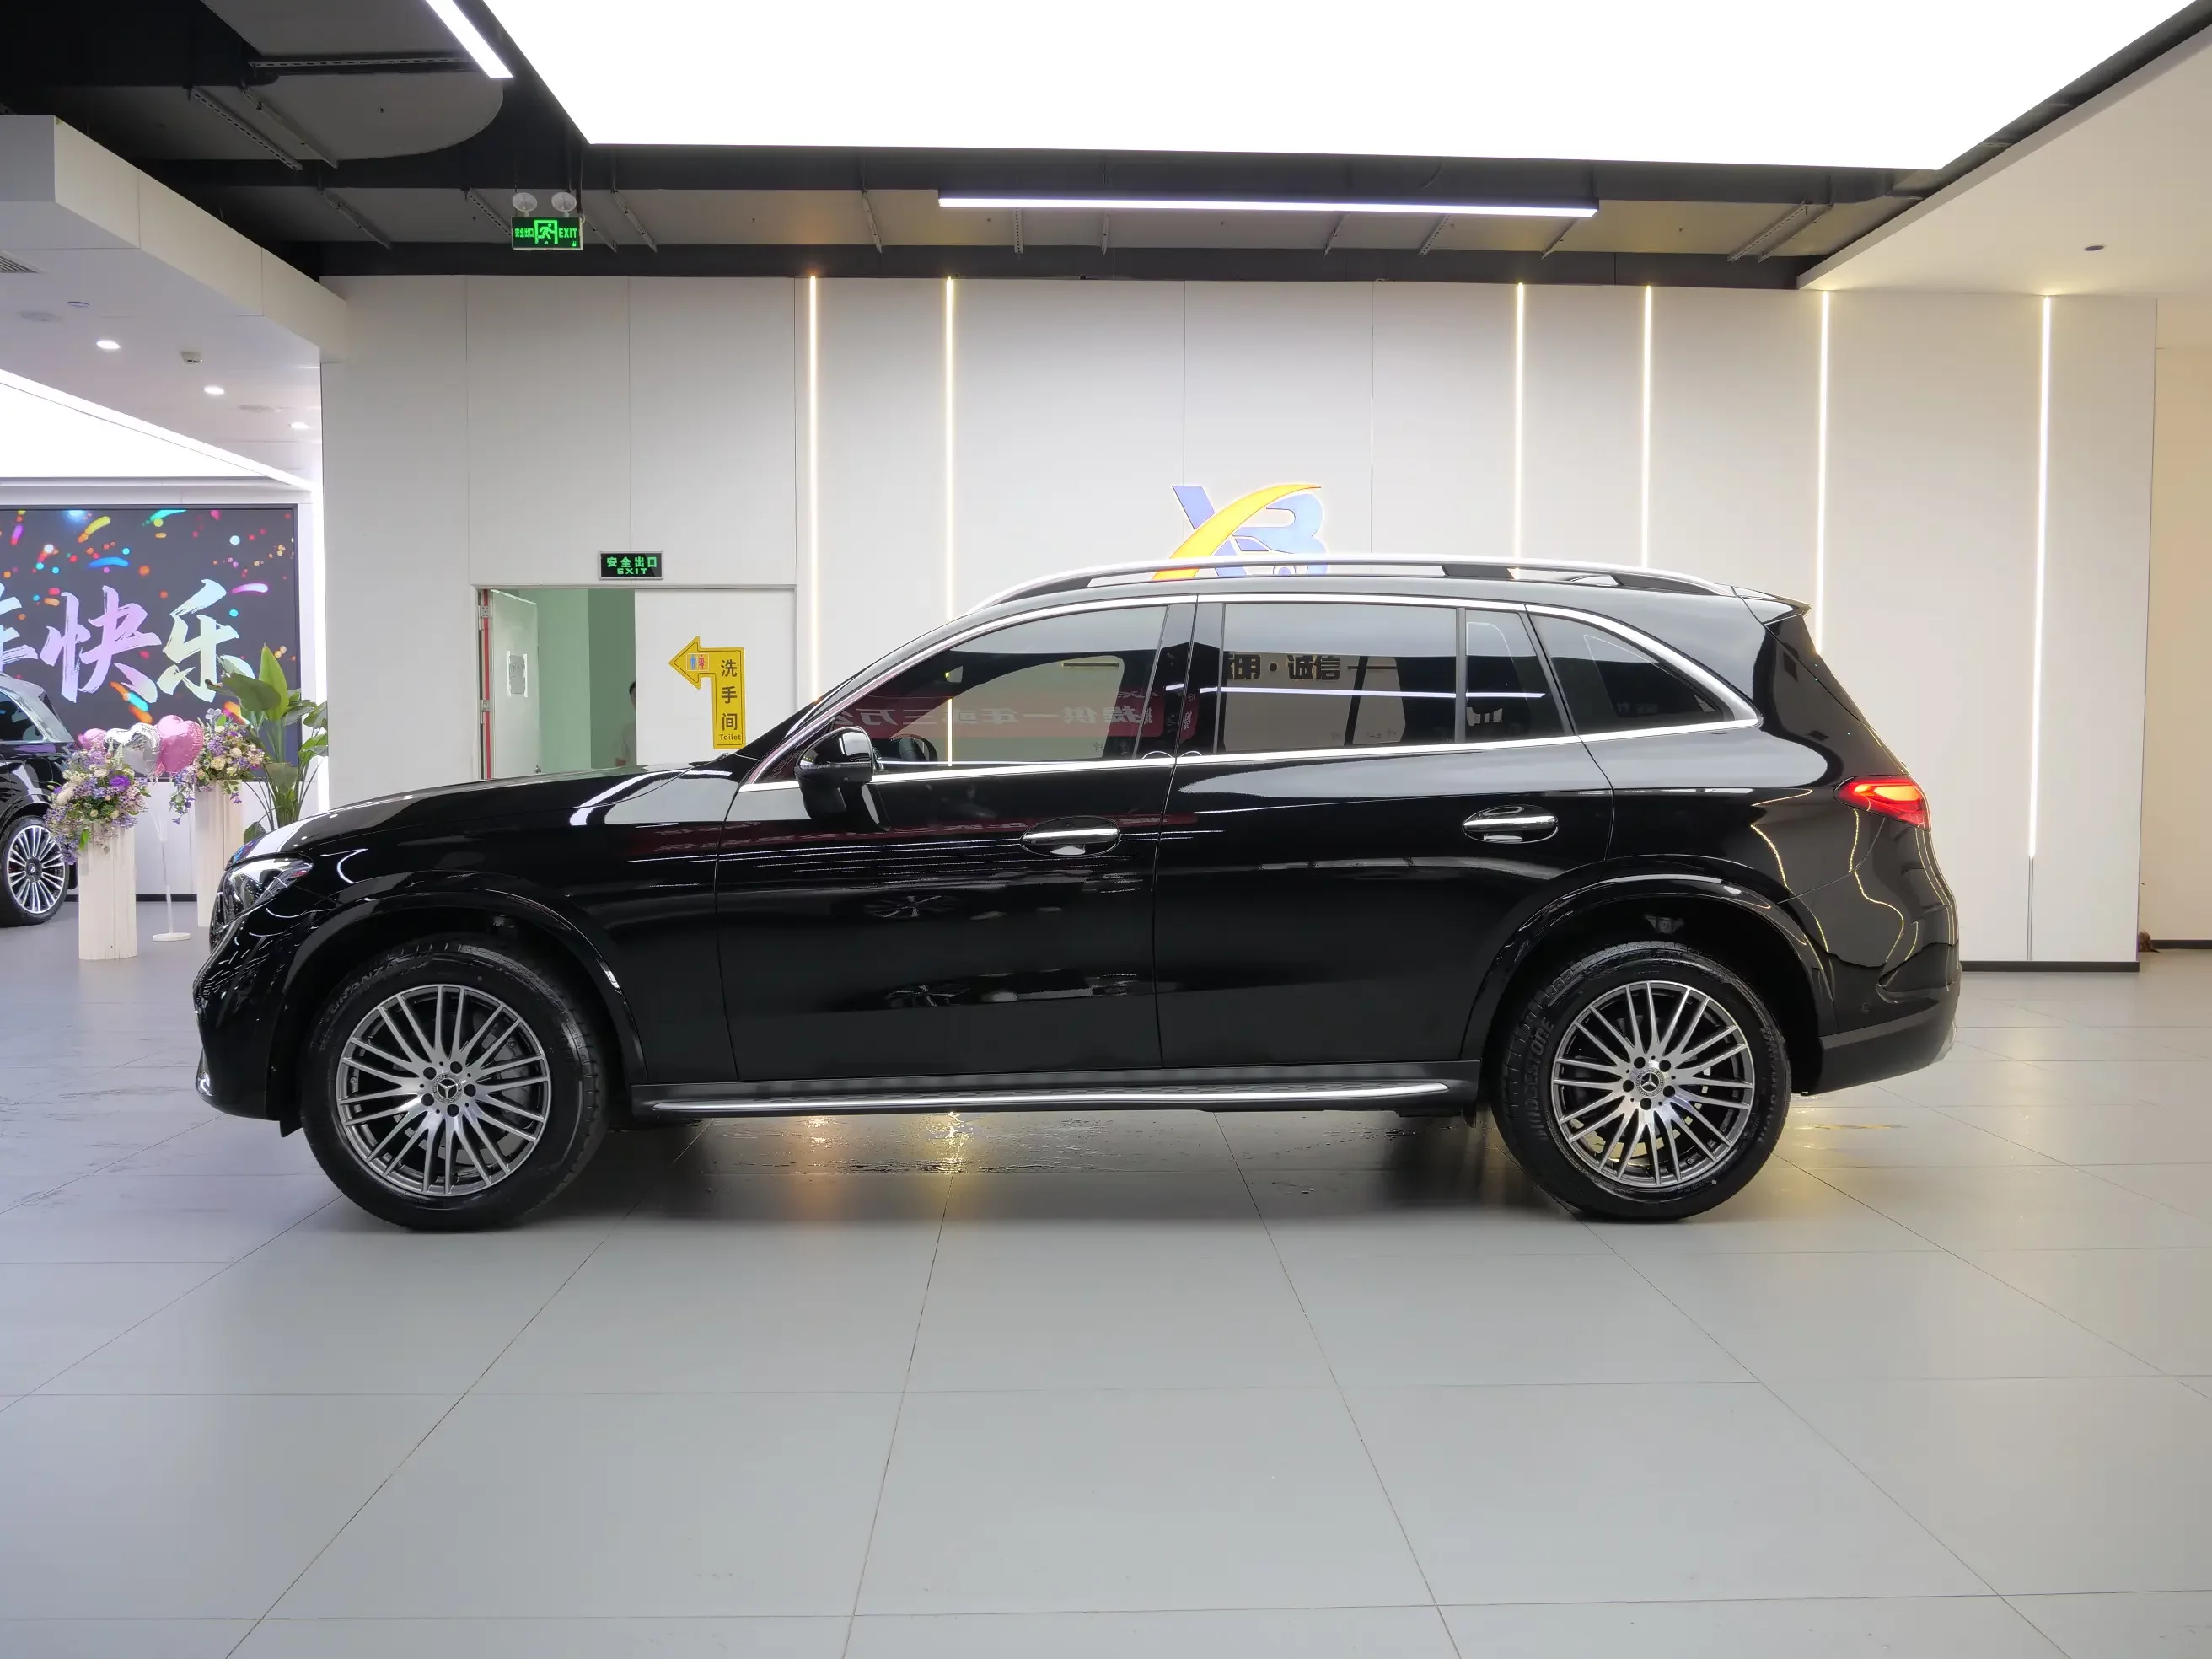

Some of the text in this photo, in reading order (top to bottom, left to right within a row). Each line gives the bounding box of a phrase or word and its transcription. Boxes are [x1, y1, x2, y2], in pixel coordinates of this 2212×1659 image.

[559, 228, 577, 238] EXIT
[607, 556, 657, 567] 安全出口
[721, 659, 738, 731] 洗手间
